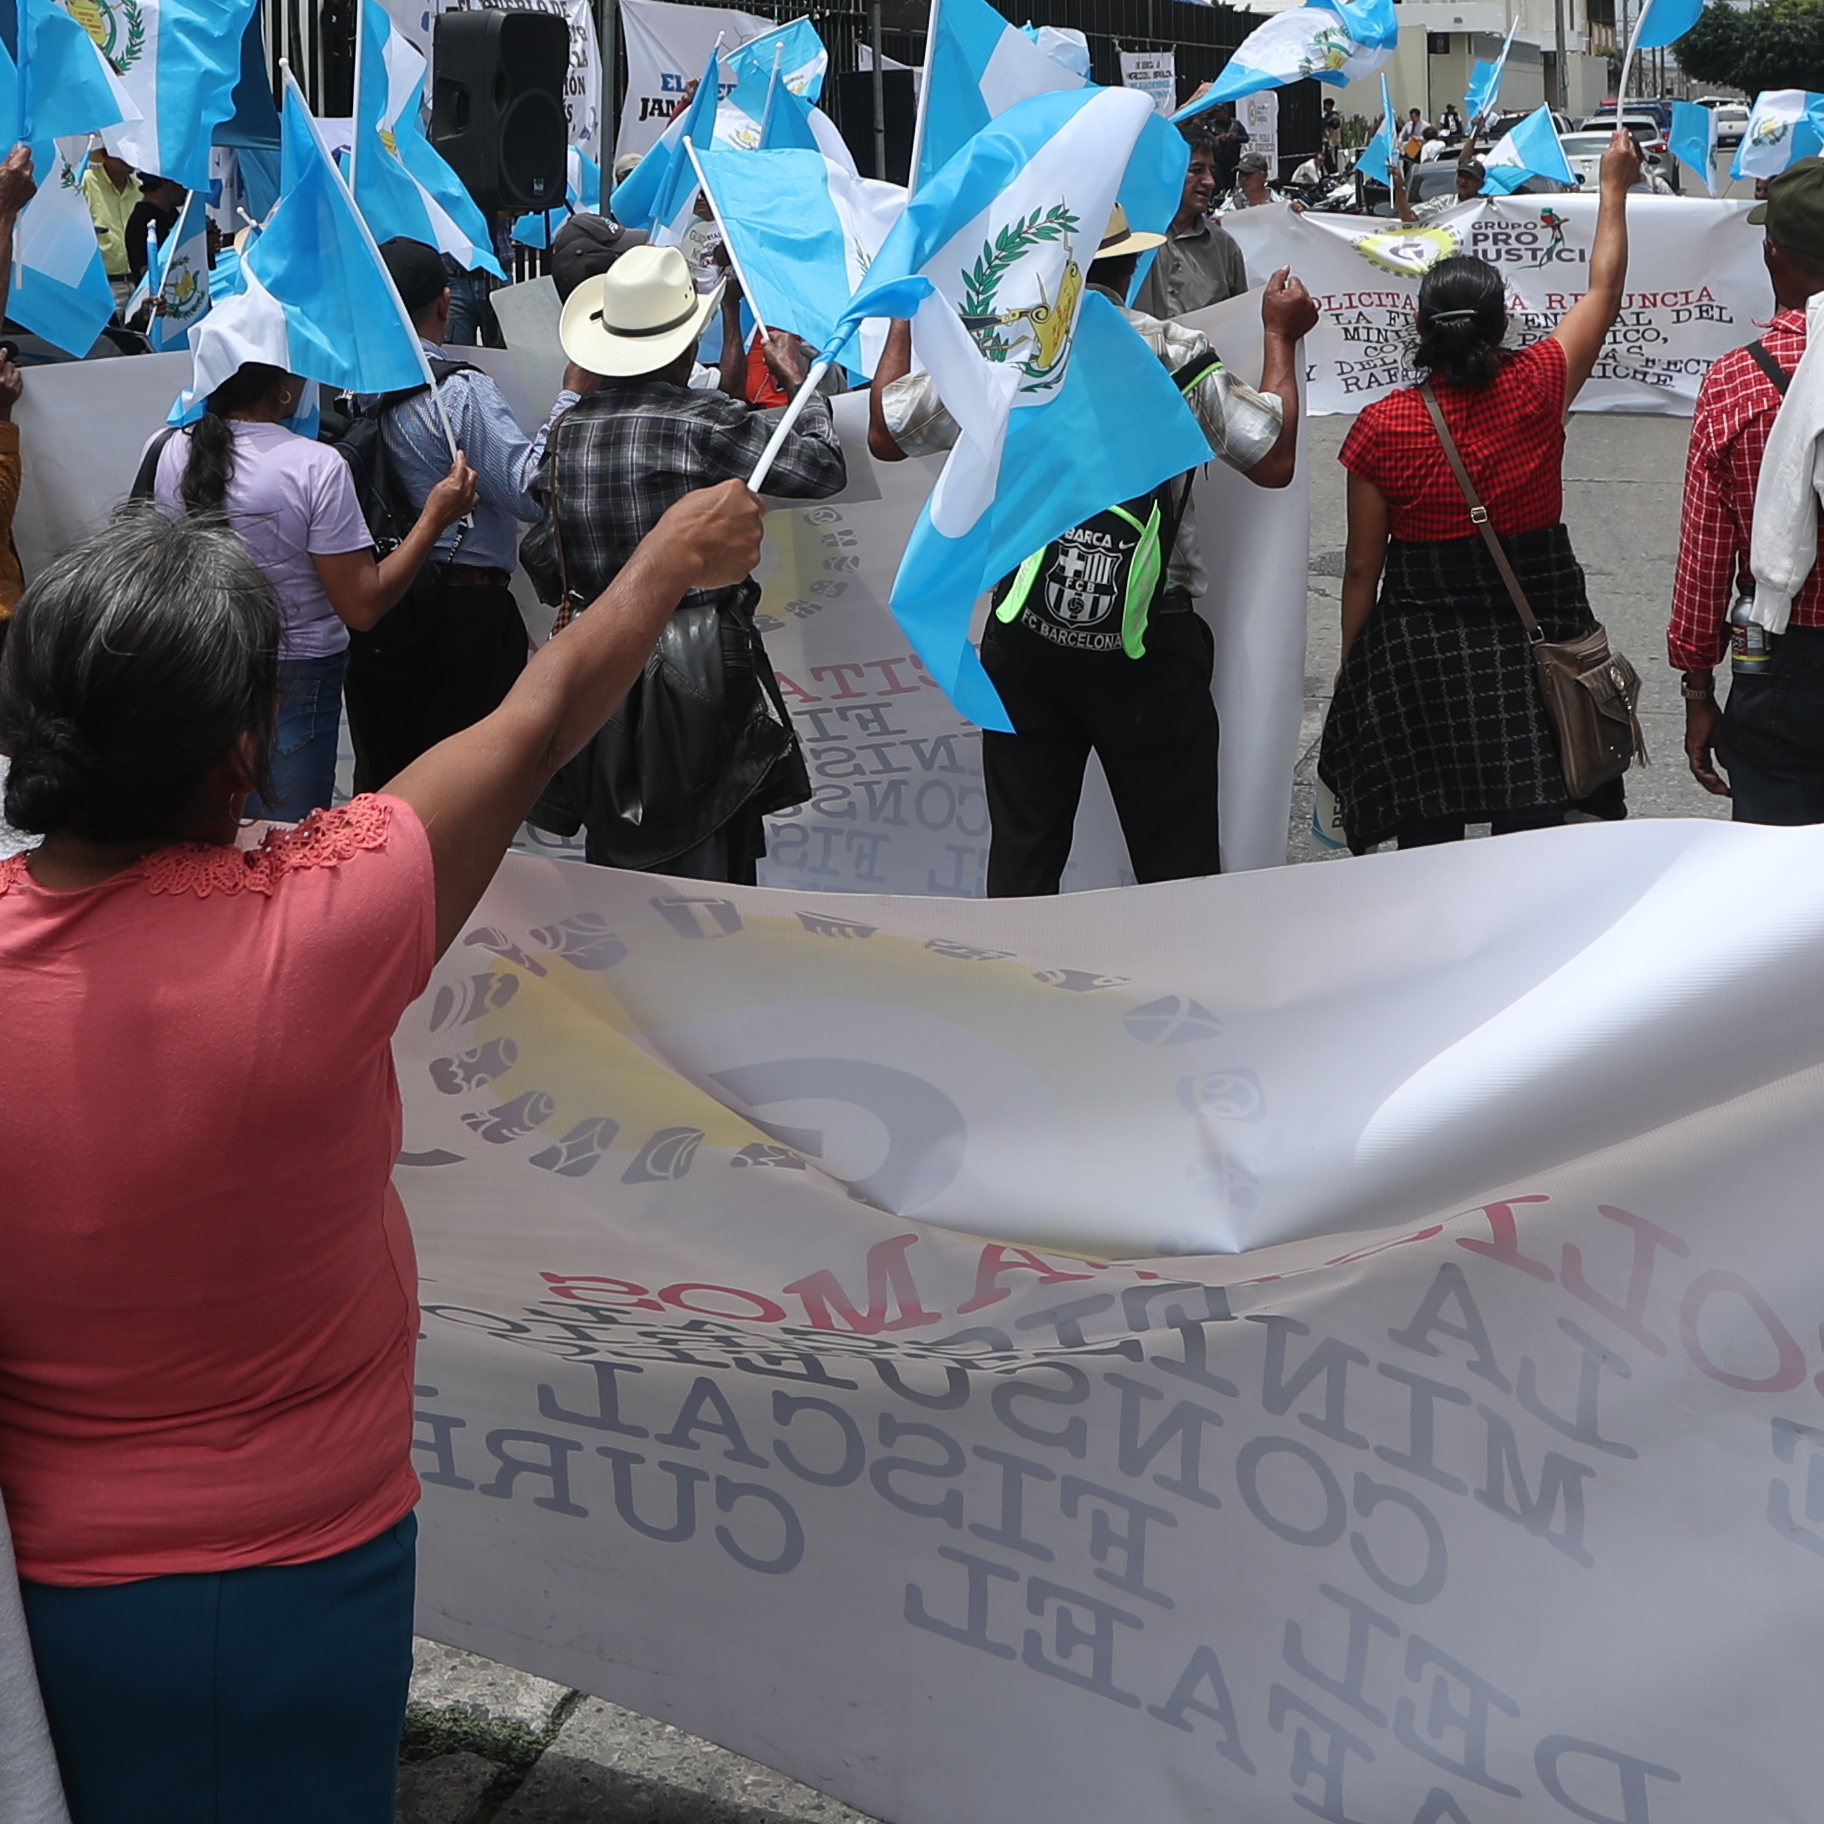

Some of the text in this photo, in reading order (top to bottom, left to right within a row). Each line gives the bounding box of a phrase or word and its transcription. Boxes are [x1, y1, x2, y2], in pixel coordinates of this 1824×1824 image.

[1471, 220, 1538, 232] GRUPO
[1472, 231, 1540, 247] PRO
[1471, 246, 1586, 264] JUSTICI
[1329, 310, 1374, 326] LA
[1670, 302, 1735, 325] DEL
[1333, 355, 1398, 377] DEL
[1039, 624, 1123, 650] BARCELONA
